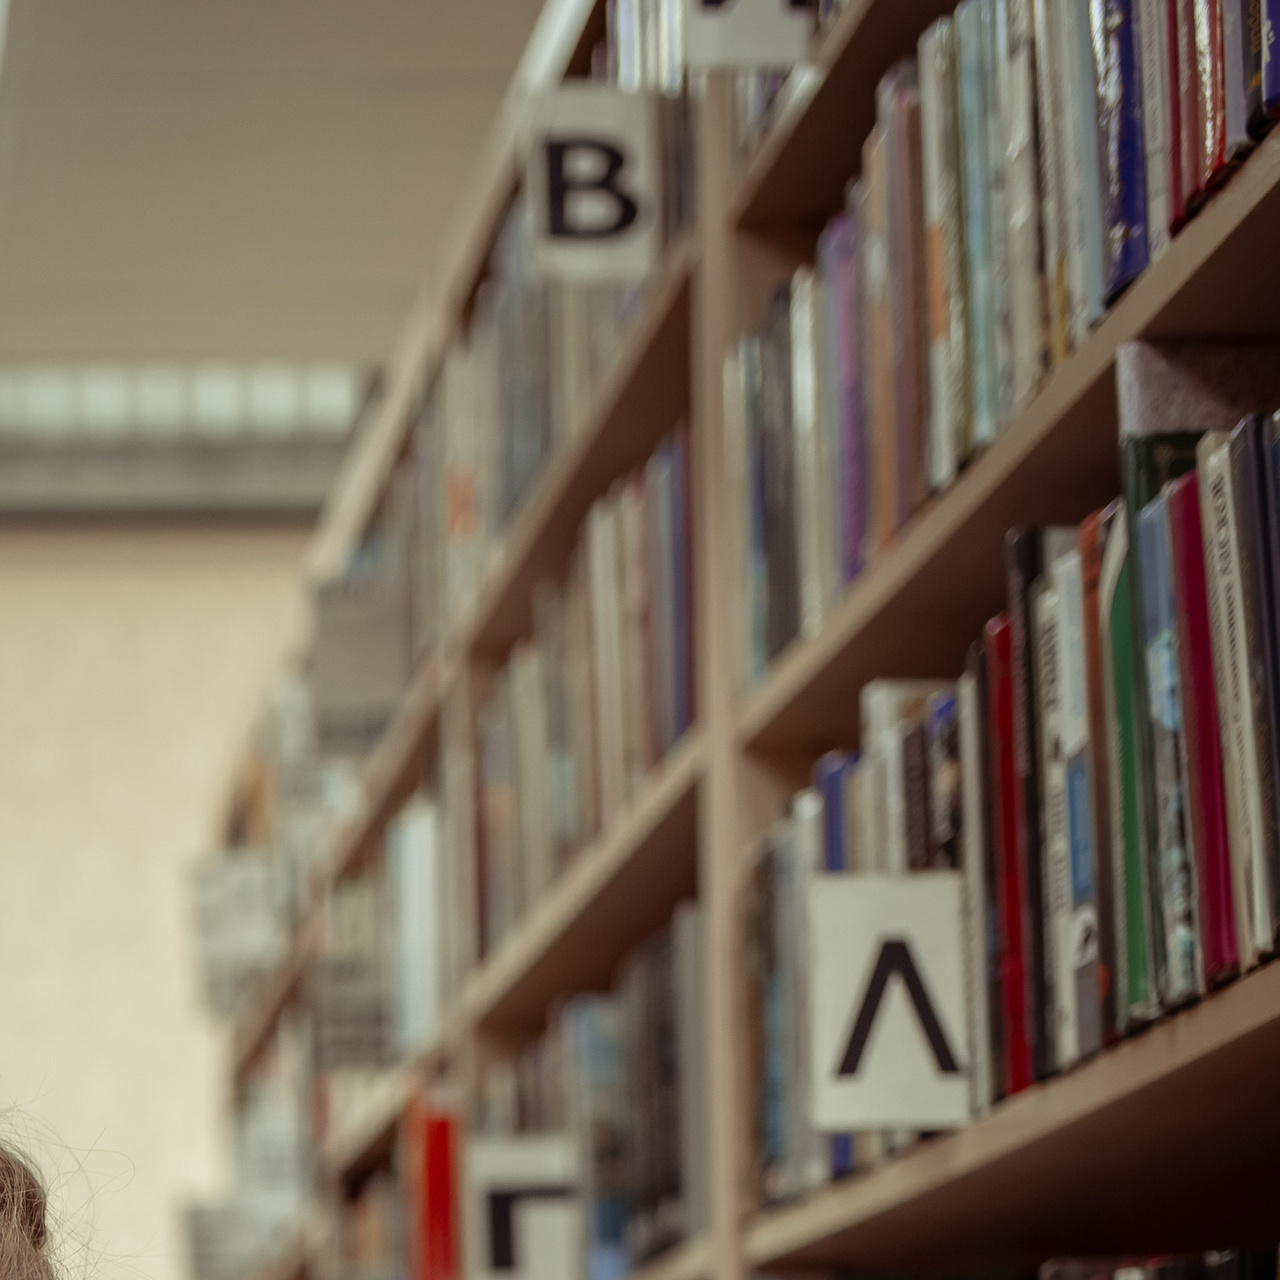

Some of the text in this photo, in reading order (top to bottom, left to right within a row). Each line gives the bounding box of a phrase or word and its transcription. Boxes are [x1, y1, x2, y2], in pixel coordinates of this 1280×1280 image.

[546, 139, 639, 238] В
[838, 939, 960, 1075] Л
[488, 1186, 577, 1270] Г
